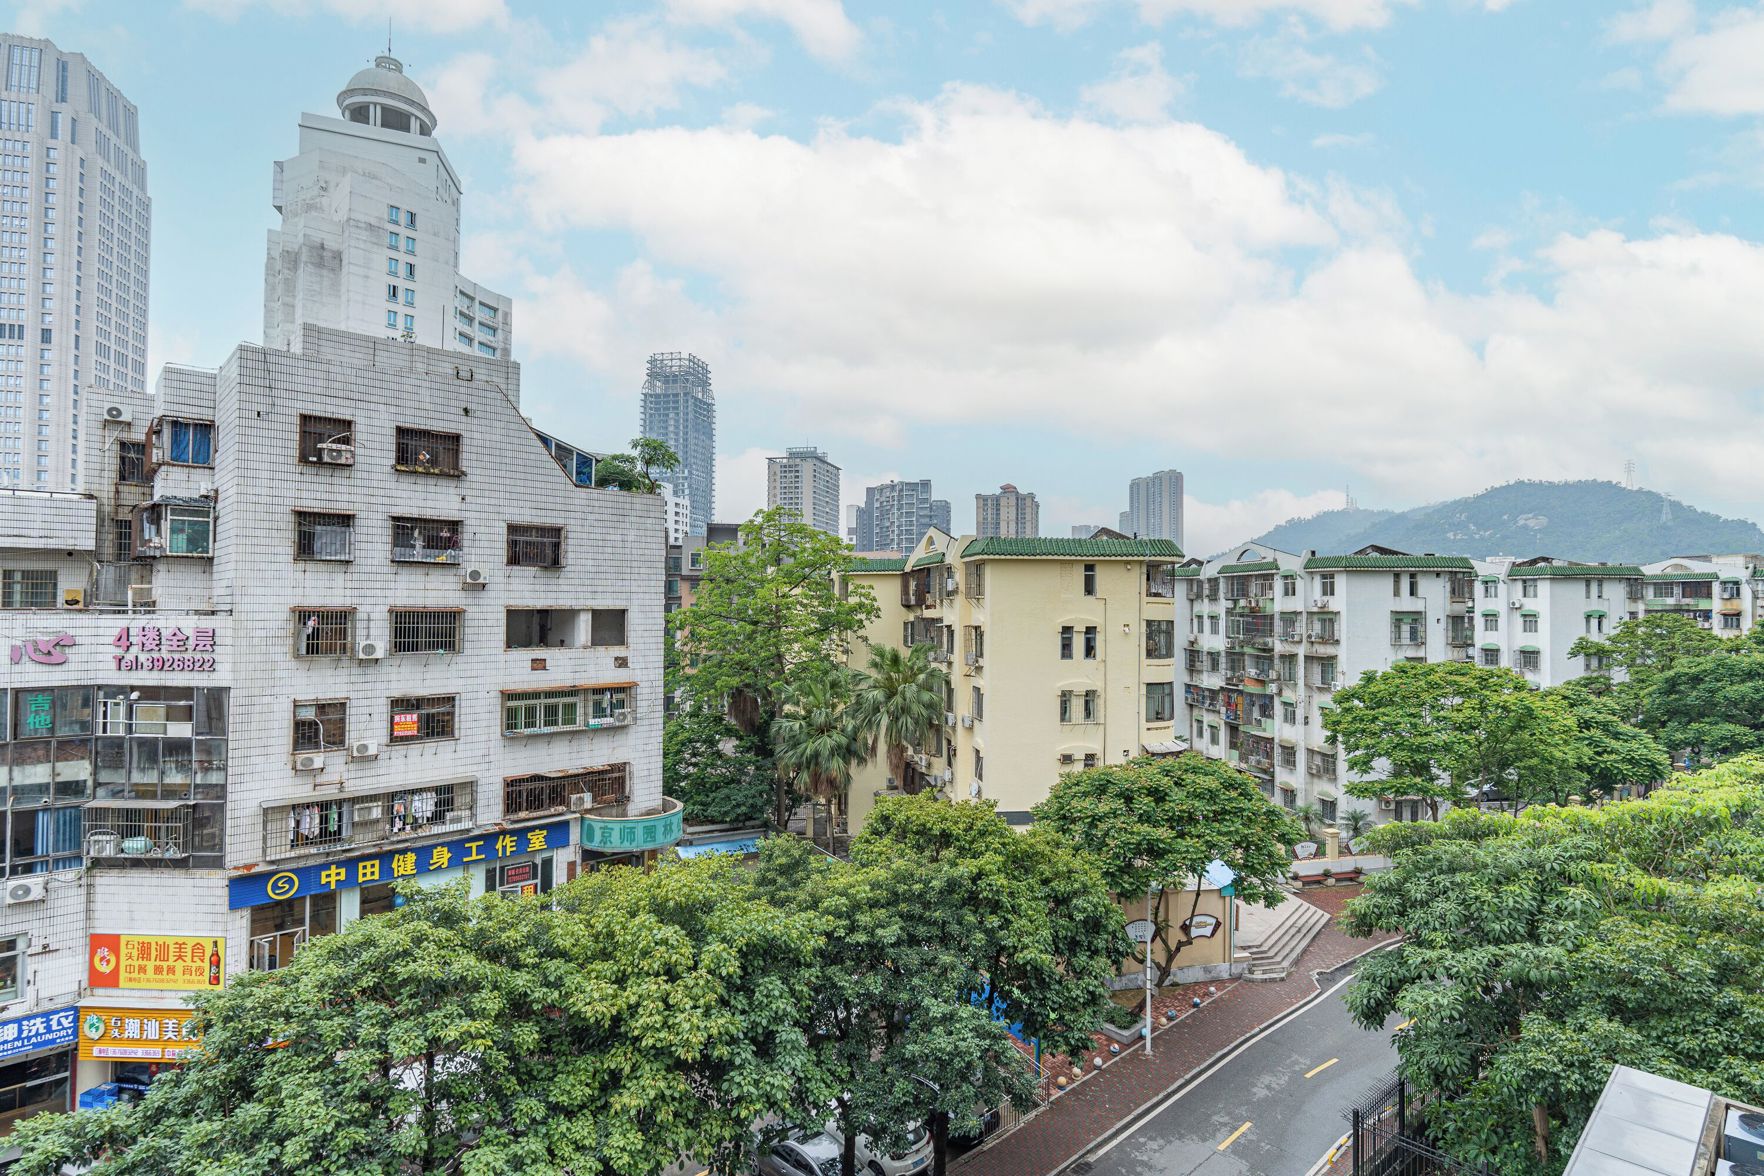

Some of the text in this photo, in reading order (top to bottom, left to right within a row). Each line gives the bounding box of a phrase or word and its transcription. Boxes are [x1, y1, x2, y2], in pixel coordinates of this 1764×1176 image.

[112, 626, 216, 652] 4楼全层
[27, 694, 53, 729] 吉他
[321, 829, 548, 890] 中田健身工作室
[125, 940, 136, 962] 石头
[136, 940, 206, 964] 潮汕美食
[125, 964, 206, 978] 中餐 晚餐 宵夜
[23, 1028, 74, 1046] LAUNDRY
